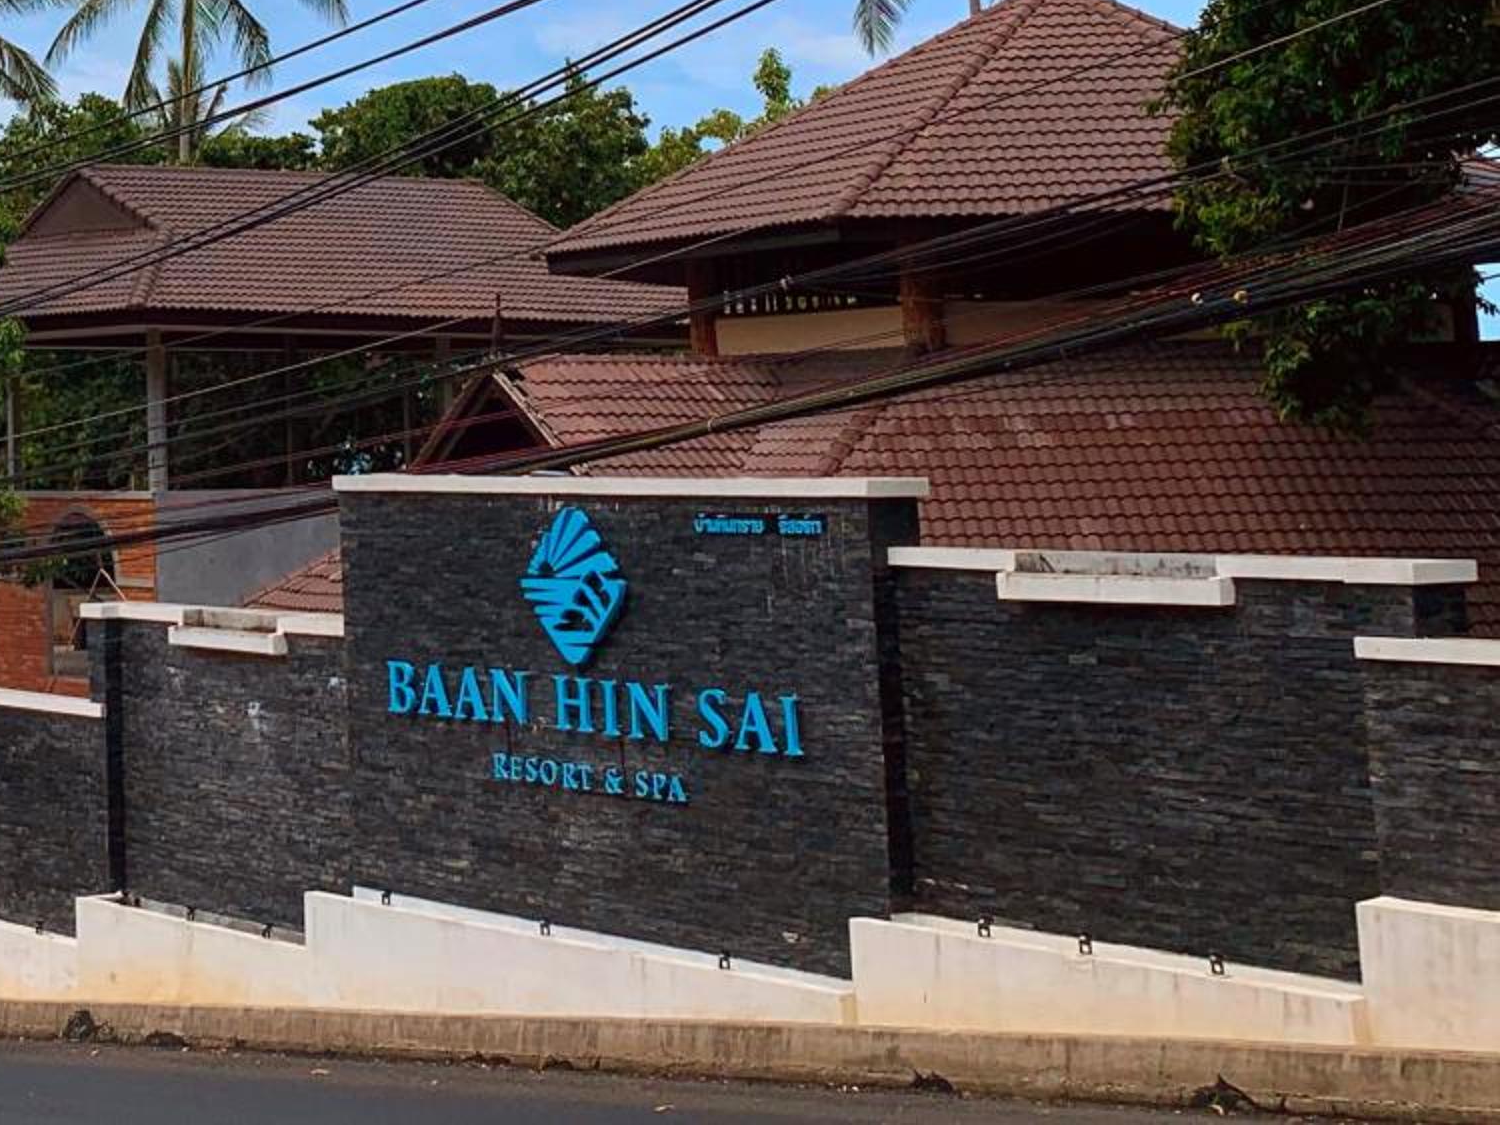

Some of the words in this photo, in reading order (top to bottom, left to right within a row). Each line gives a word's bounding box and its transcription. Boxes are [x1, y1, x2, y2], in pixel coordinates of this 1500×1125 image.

[386, 660, 528, 726] BAAN
[553, 674, 669, 743] HIN
[697, 688, 804, 758] SAI
[492, 752, 593, 791] RESORT
[604, 769, 624, 795] &
[635, 772, 688, 803] SPA
